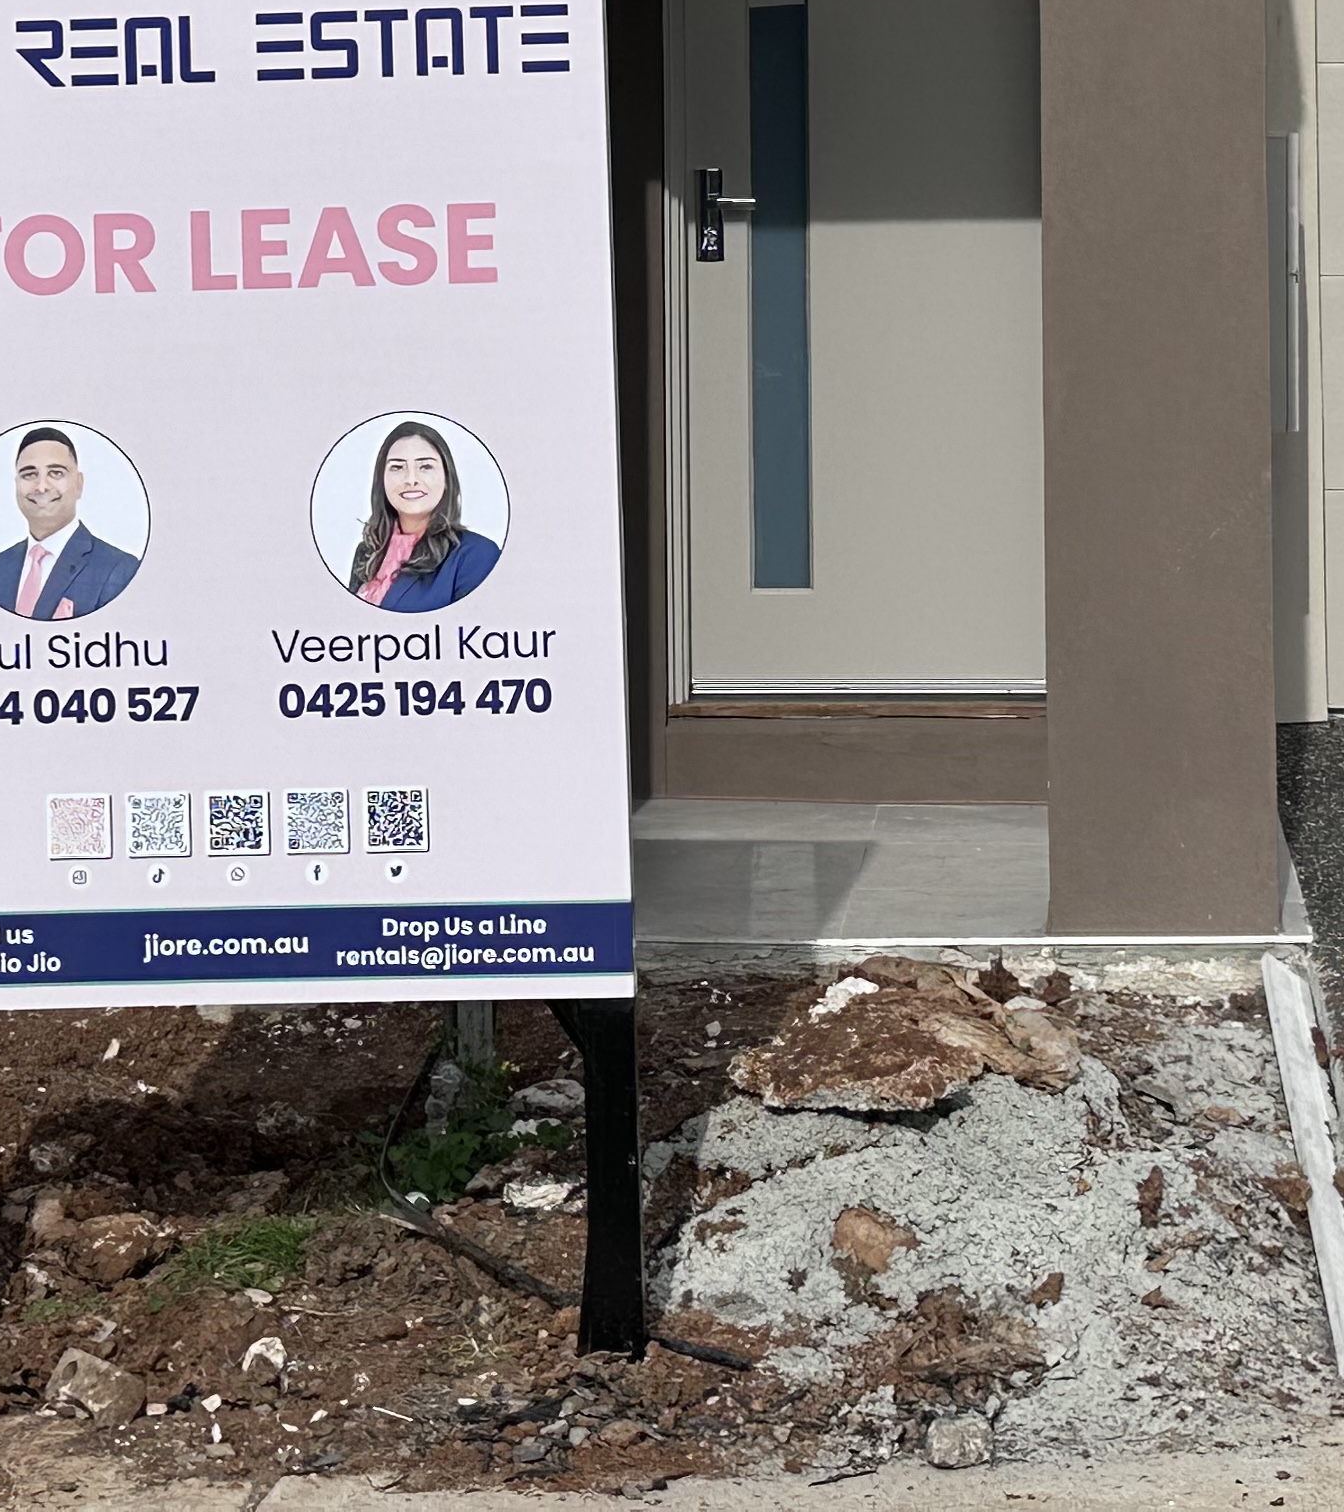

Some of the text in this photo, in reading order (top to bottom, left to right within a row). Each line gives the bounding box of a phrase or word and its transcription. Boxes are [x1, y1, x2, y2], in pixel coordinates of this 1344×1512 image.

[15, 15, 216, 88] REAL
[255, 3, 571, 82] ESTATE
[190, 202, 499, 292] LEASE
[47, 631, 168, 669] Sidhu
[271, 623, 557, 674] Veerpal Kaur
[33, 687, 117, 725] 040
[127, 685, 200, 723] 527
[278, 677, 552, 719] 0425 194 470
[5, 928, 35, 945] us
[382, 913, 547, 943] Drop Us a Line
[26, 951, 62, 973] Jio
[143, 933, 309, 964] jiore.com.au
[336, 943, 595, 971] rentals@jiore.com.au
